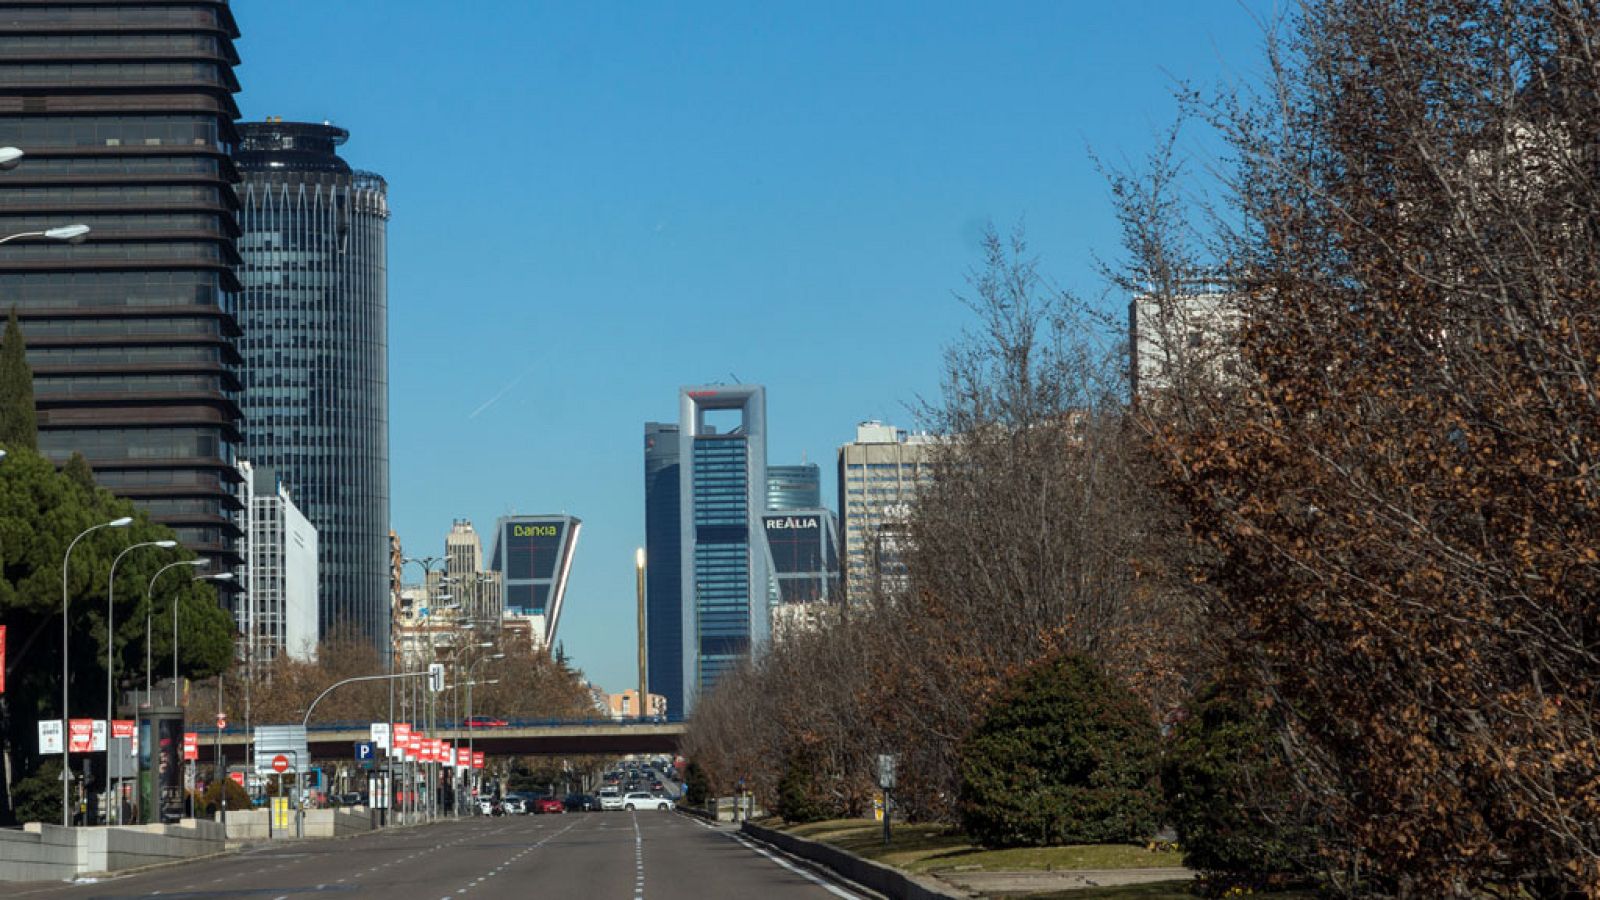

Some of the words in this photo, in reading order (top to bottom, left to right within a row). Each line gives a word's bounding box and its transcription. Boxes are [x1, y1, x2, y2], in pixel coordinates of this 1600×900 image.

[766, 516, 818, 529] REALIA
[513, 524, 557, 537] Bankia
[360, 744, 370, 759] P
